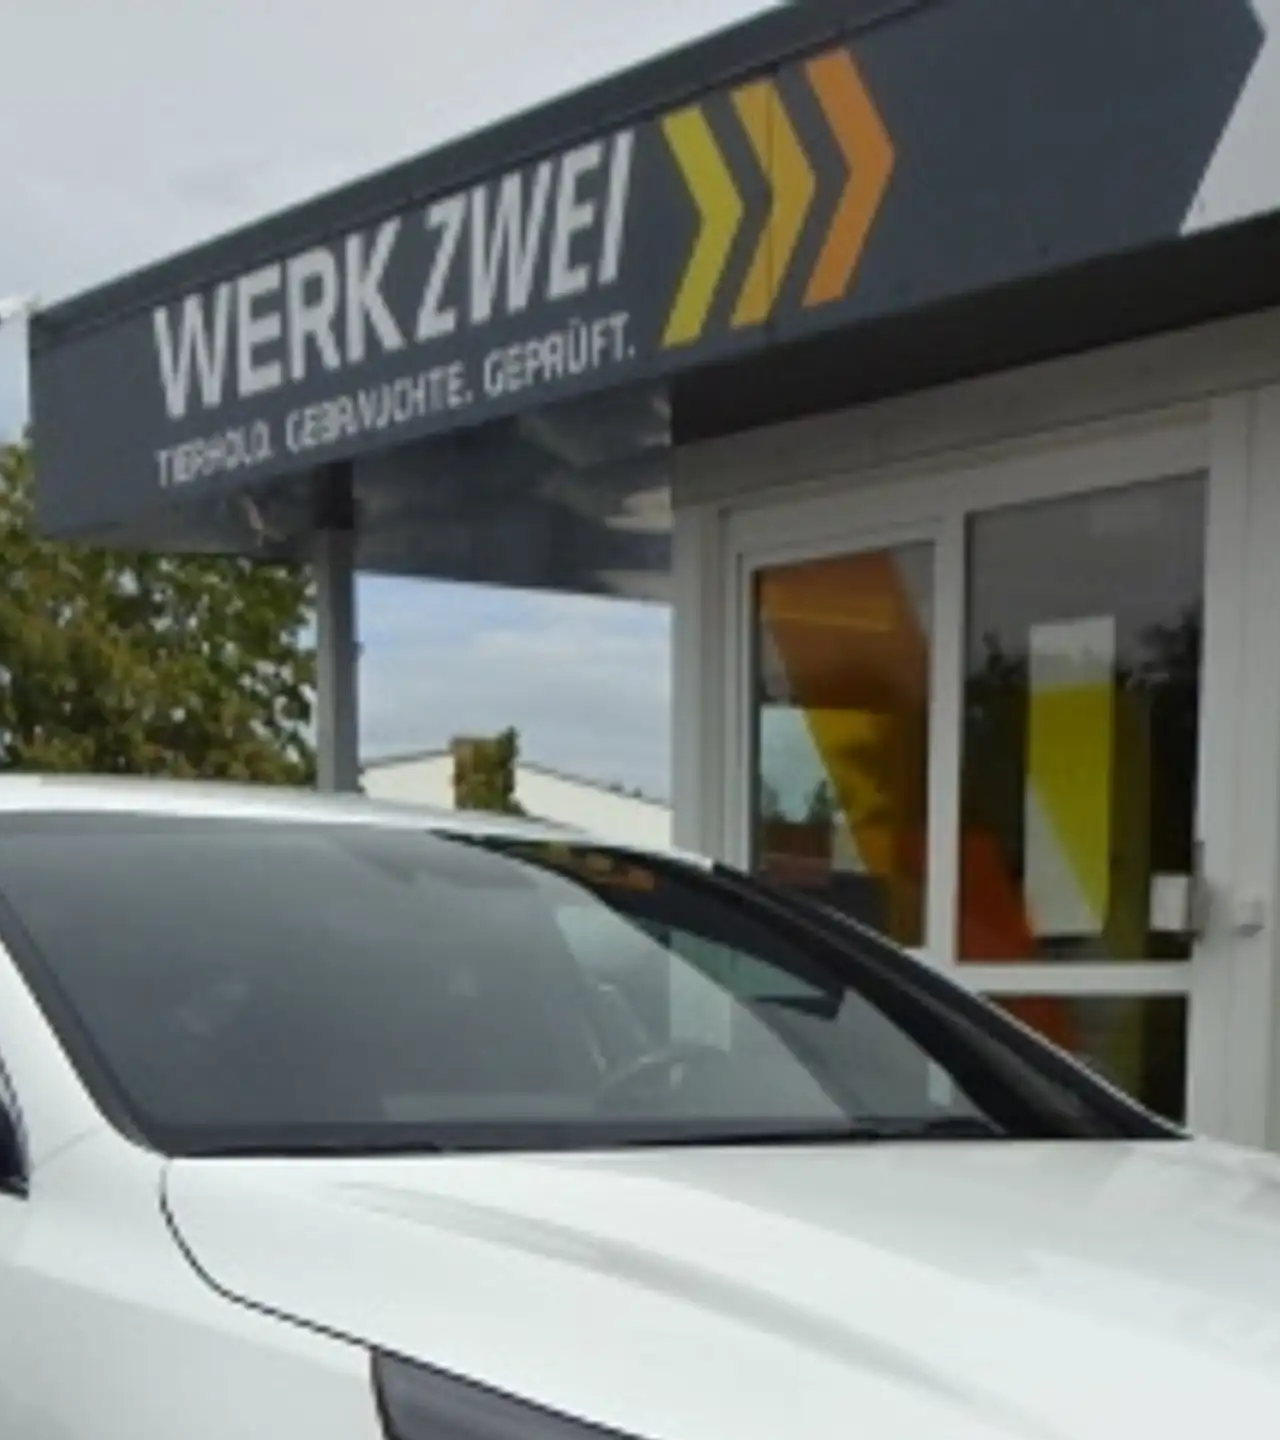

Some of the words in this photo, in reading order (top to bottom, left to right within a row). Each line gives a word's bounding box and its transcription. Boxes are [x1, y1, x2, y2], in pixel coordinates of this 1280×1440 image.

[153, 215, 408, 419] WERK
[415, 129, 635, 343] ZWEI
[483, 311, 636, 397] GEPRÜFT.
